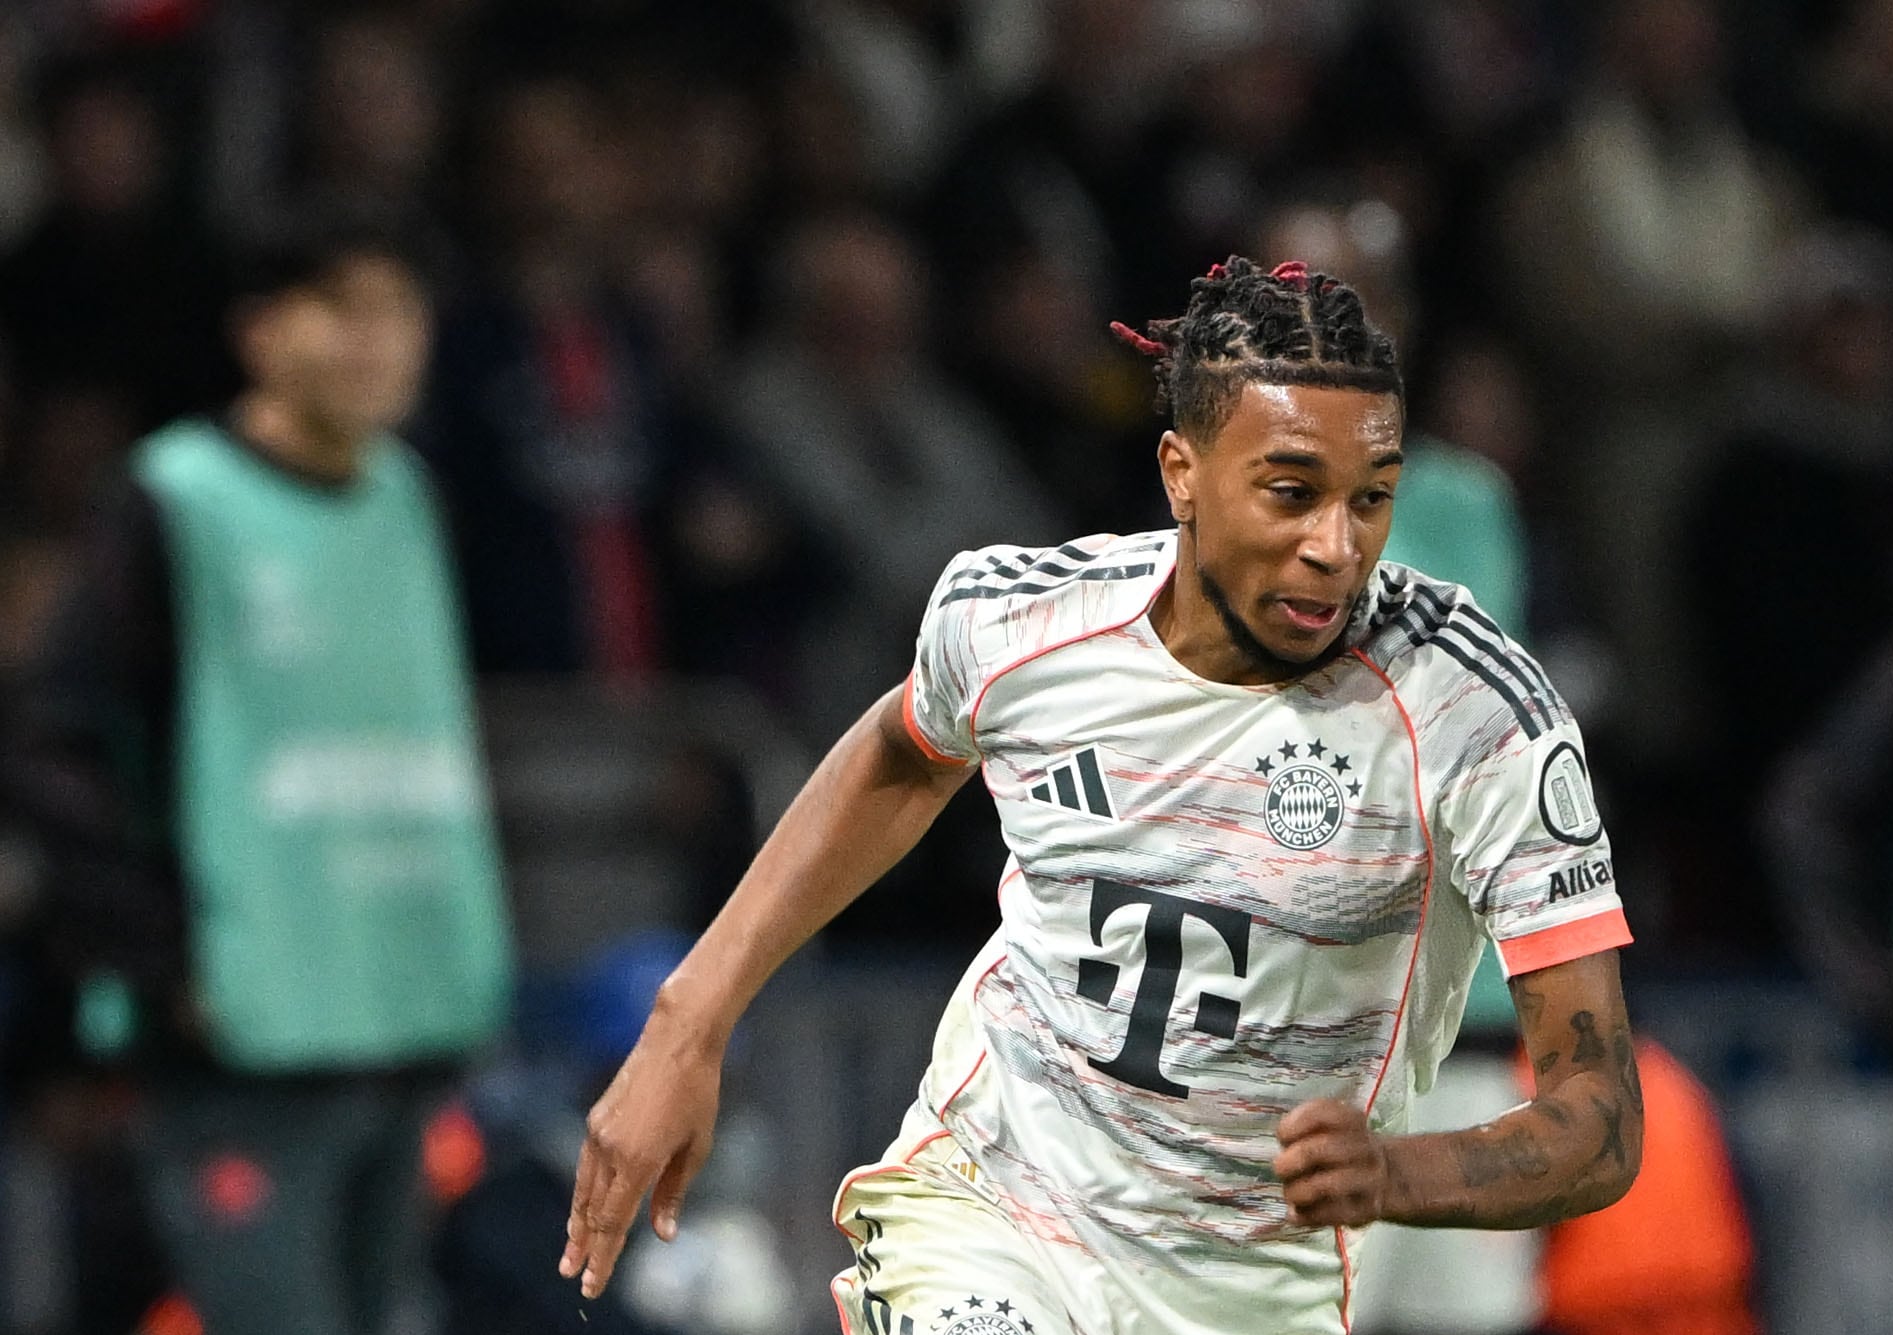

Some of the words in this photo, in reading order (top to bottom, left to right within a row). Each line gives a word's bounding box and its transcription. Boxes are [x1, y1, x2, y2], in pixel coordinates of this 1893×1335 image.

[1273, 776, 1291, 796] FC
[1292, 771, 1338, 808] BAYERN
[1548, 858, 1614, 904] Allia
[1077, 878, 1252, 1099] T
